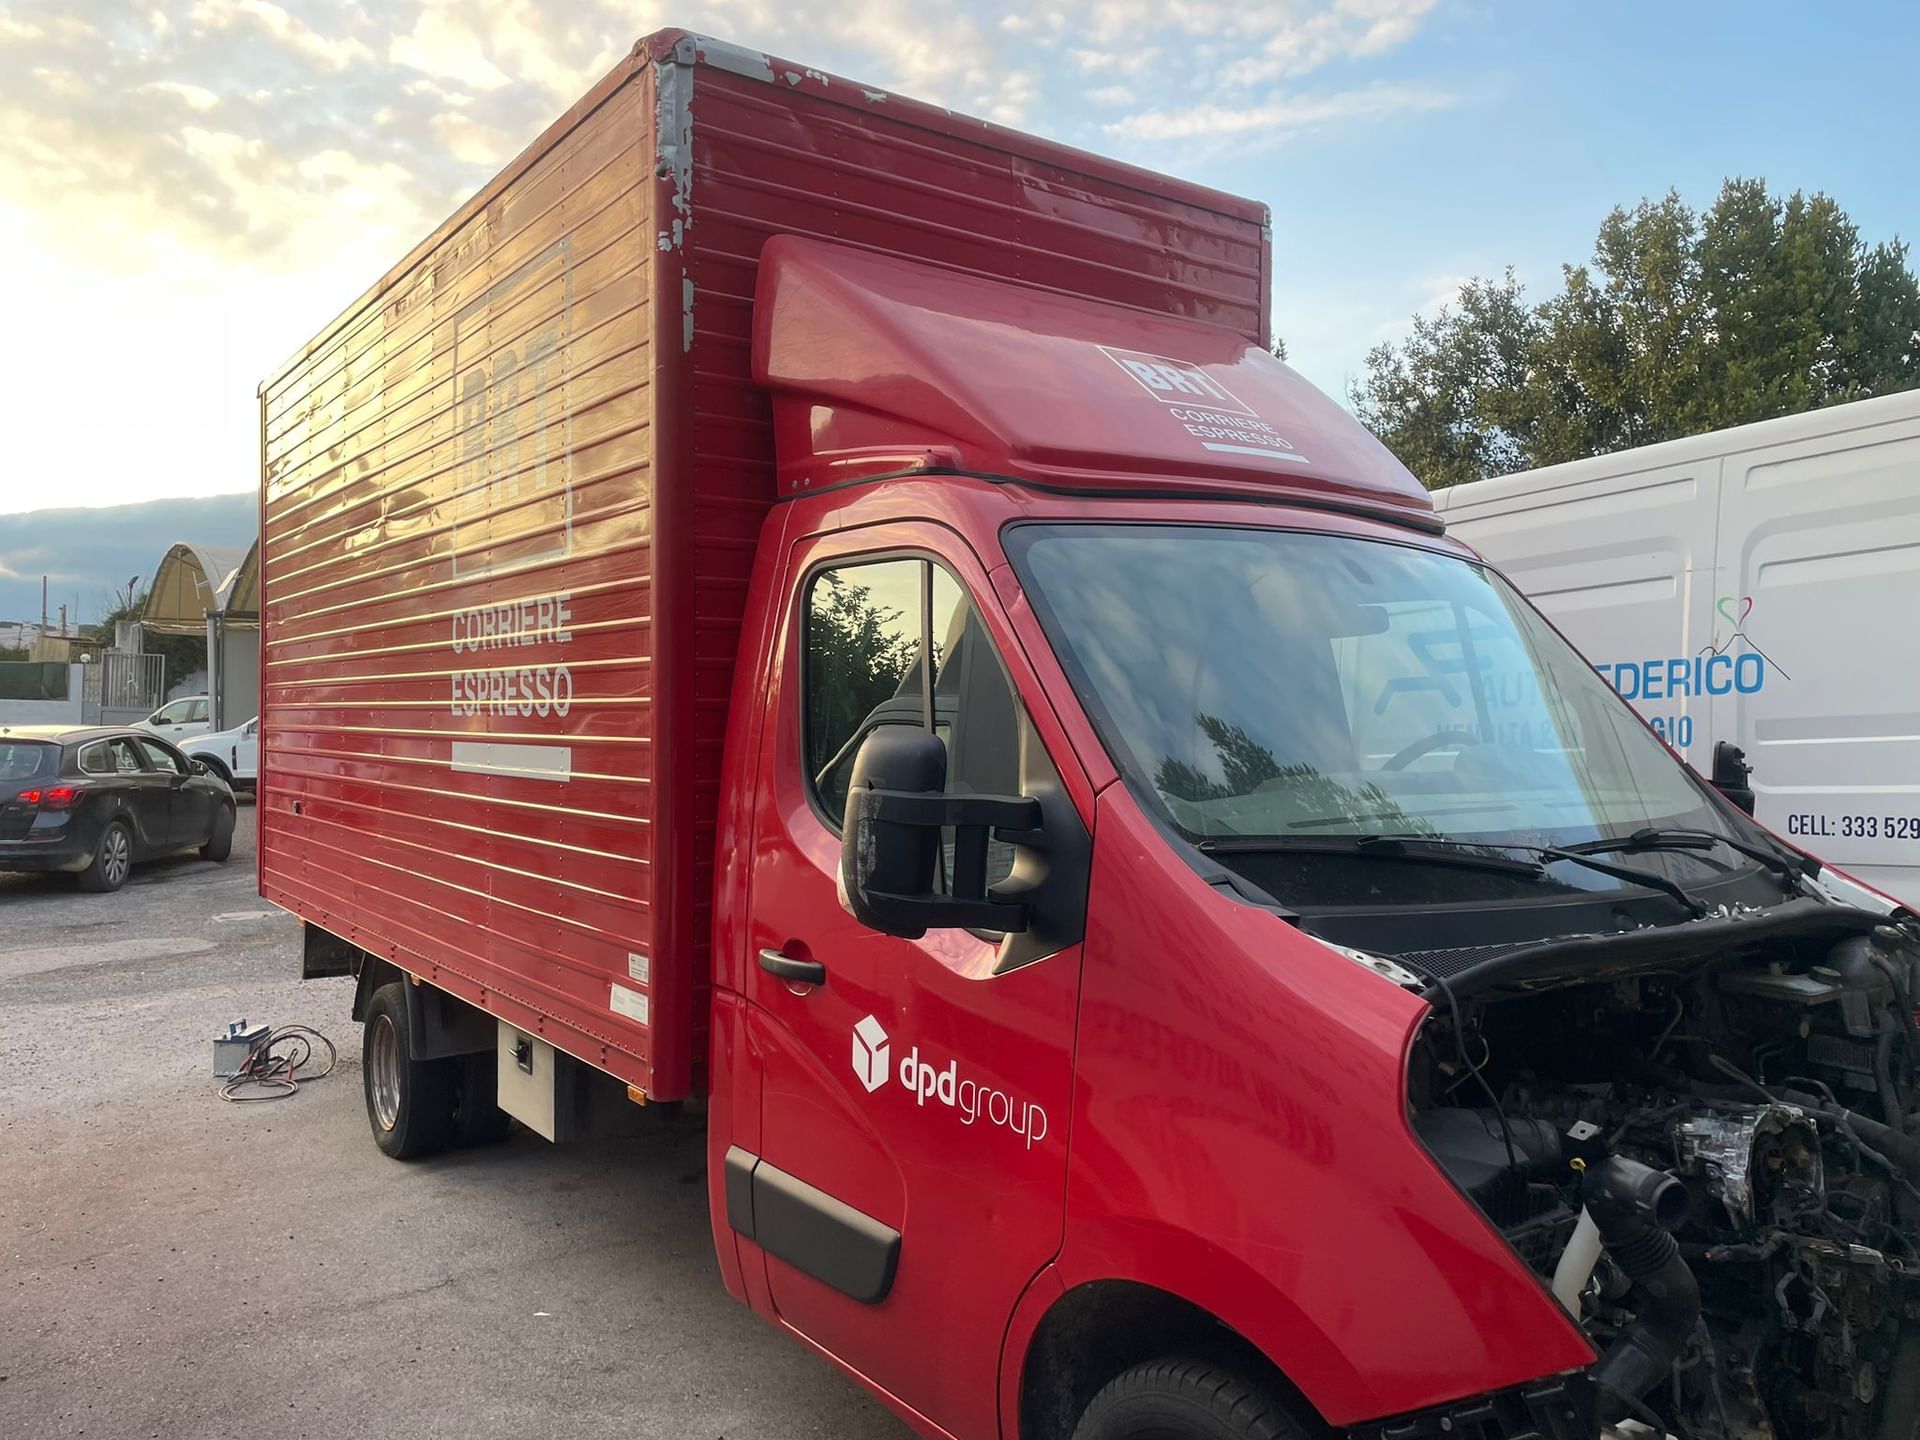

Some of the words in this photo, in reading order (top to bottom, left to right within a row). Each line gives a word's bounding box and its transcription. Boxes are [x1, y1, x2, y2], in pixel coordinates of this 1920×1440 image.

[1122, 359, 1225, 400] BRT
[463, 326, 560, 512] BRT
[1169, 408, 1279, 435] CORRIERE
[1184, 424, 1294, 450] ESPRESSO
[452, 592, 572, 654] CORRIERE
[451, 666, 572, 718] ESPRESSO
[1788, 814, 1836, 836] CELL:
[1841, 816, 1878, 838] 333
[1884, 817, 1920, 839] 529
[900, 1046, 1047, 1150] dpdgroup
